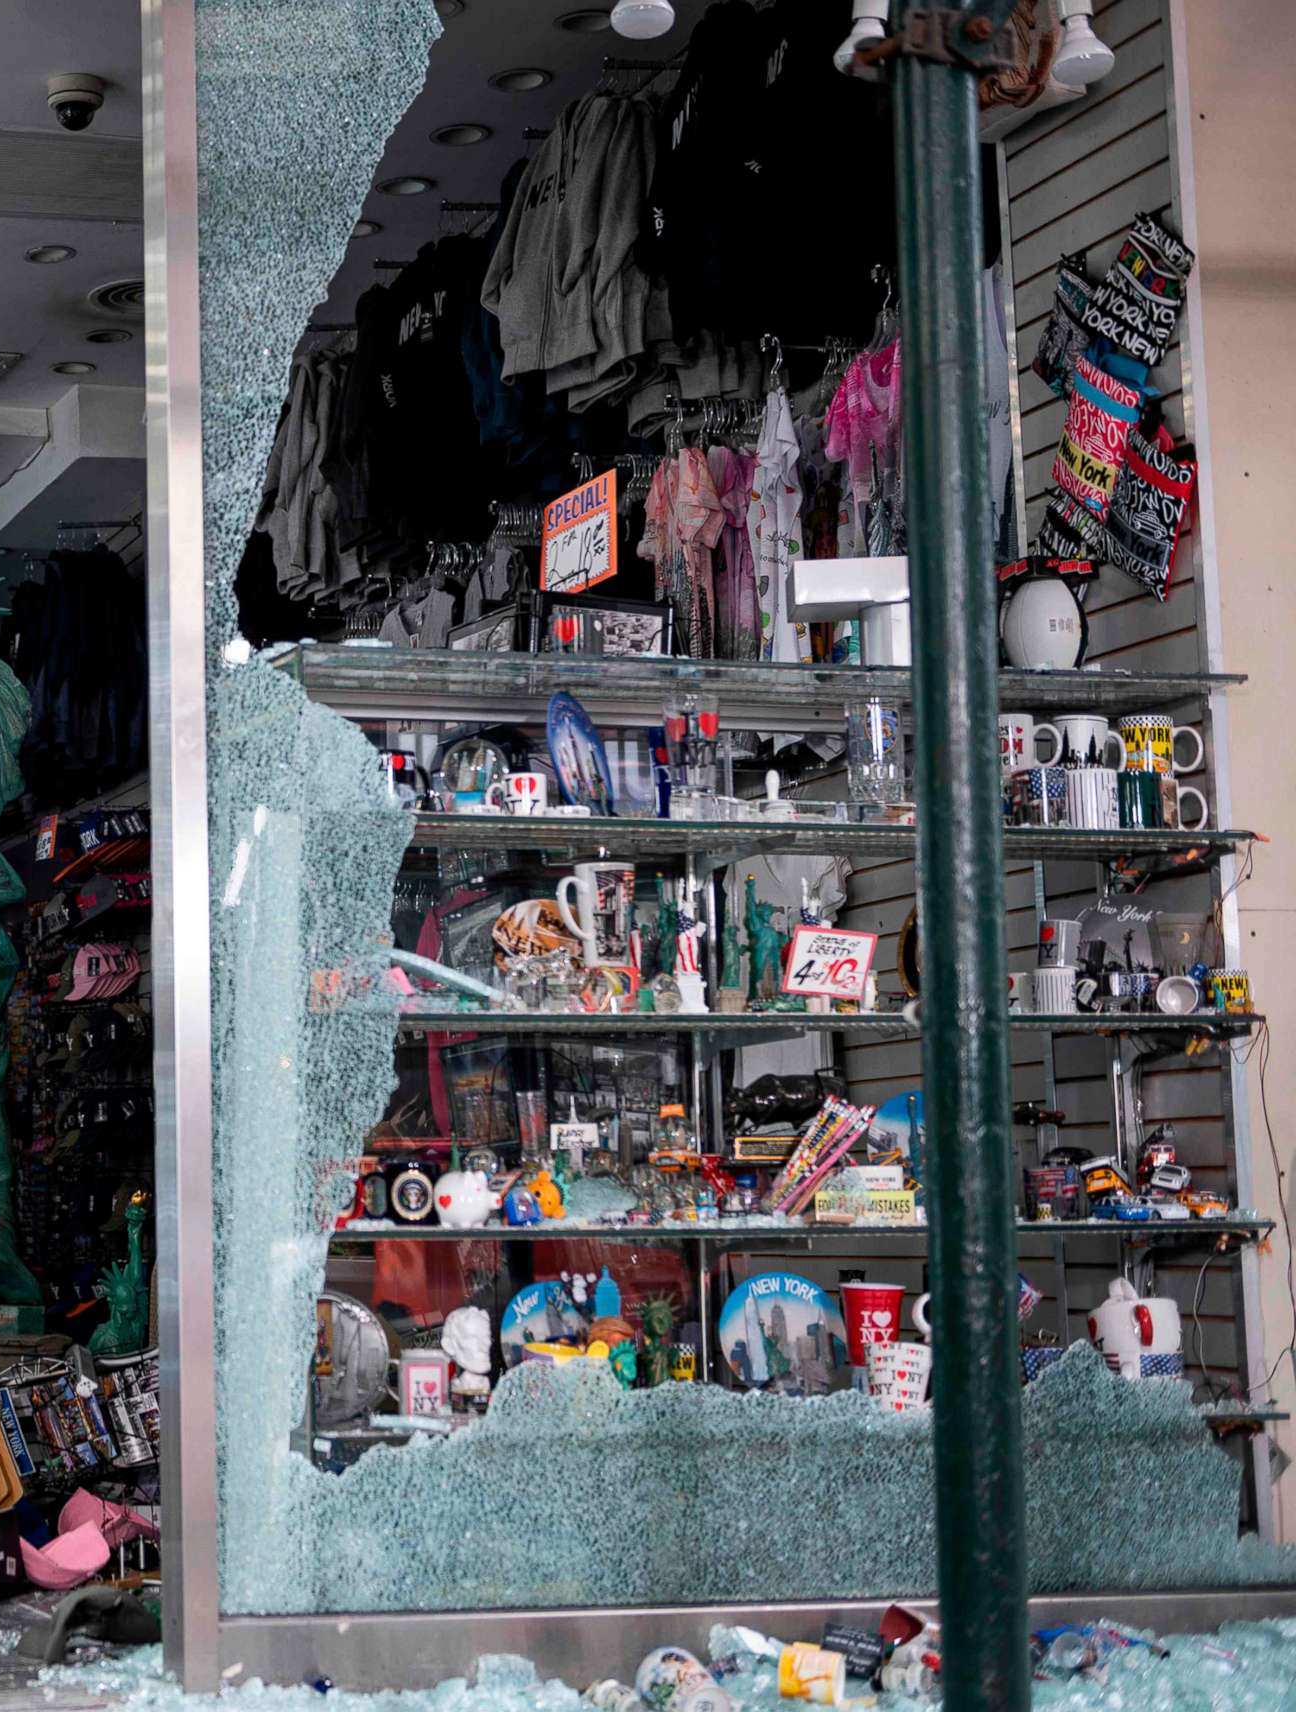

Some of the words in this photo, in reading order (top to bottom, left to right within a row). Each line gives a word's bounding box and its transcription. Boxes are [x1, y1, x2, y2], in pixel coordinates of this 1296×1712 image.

[398, 302, 422, 346] NEW
[1081, 302, 1124, 344] YORK
[1121, 330, 1160, 367] NEW
[1059, 435, 1078, 468] New
[1077, 455, 1112, 489] York
[547, 477, 608, 531] SPECIAL!
[1000, 738, 1023, 754] OM
[1139, 727, 1171, 743] YORK
[1092, 899, 1117, 915] New
[1117, 904, 1153, 923] York
[807, 943, 853, 956] LIBERTY
[793, 960, 816, 986] 4
[1221, 978, 1245, 990] NEW
[750, 1277, 780, 1297] NEW
[784, 1277, 819, 1304] YORK
[511, 1290, 540, 1324] New
[874, 1384, 893, 1395] NY
[907, 1372, 923, 1384] NY
[1, 1406, 18, 1431] NEW
[7, 1431, 26, 1459] YORK
